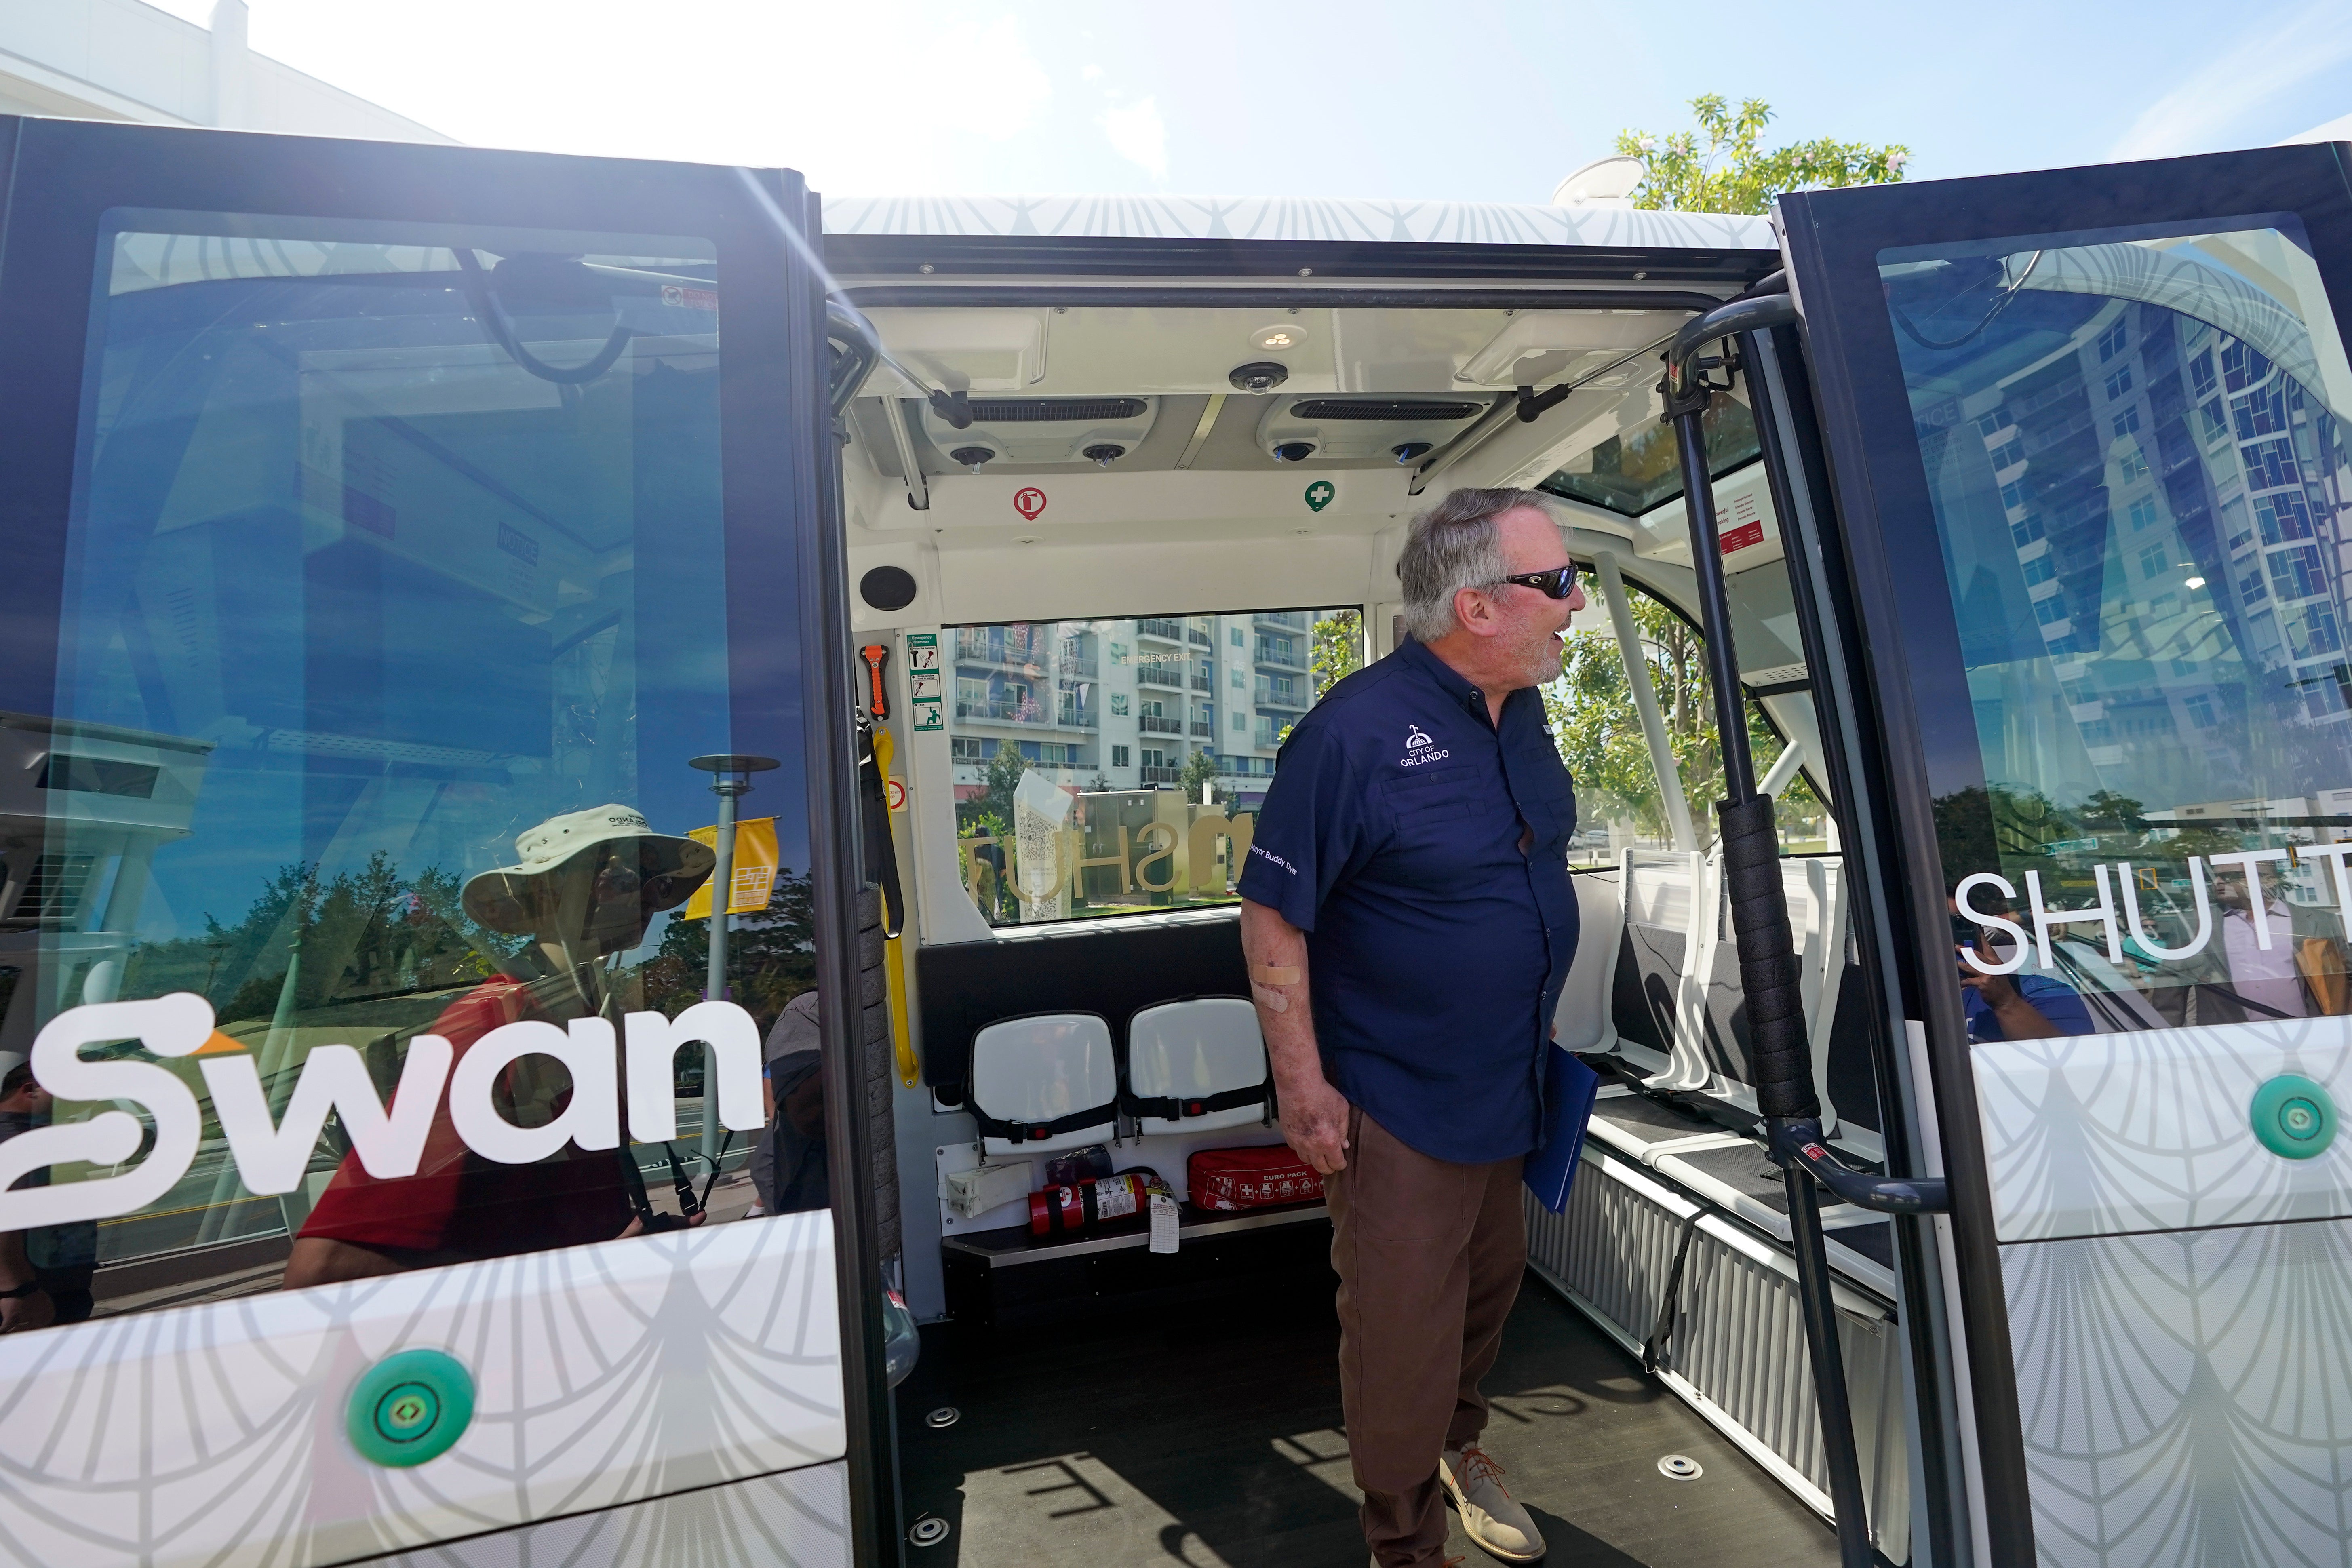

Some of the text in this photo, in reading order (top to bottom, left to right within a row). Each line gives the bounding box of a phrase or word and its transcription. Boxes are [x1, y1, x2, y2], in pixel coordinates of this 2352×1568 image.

[1716, 506, 1729, 516] owerful
[500, 528, 537, 561] NOTICE
[1121, 653, 1191, 664] EMERGENCY EXIT
[1400, 749, 1449, 767] ORLANDO
[1408, 748, 1423, 757] CITY
[1250, 843, 1298, 876] Mayor Buddy Dyer
[0, 992, 766, 1232] Swan
